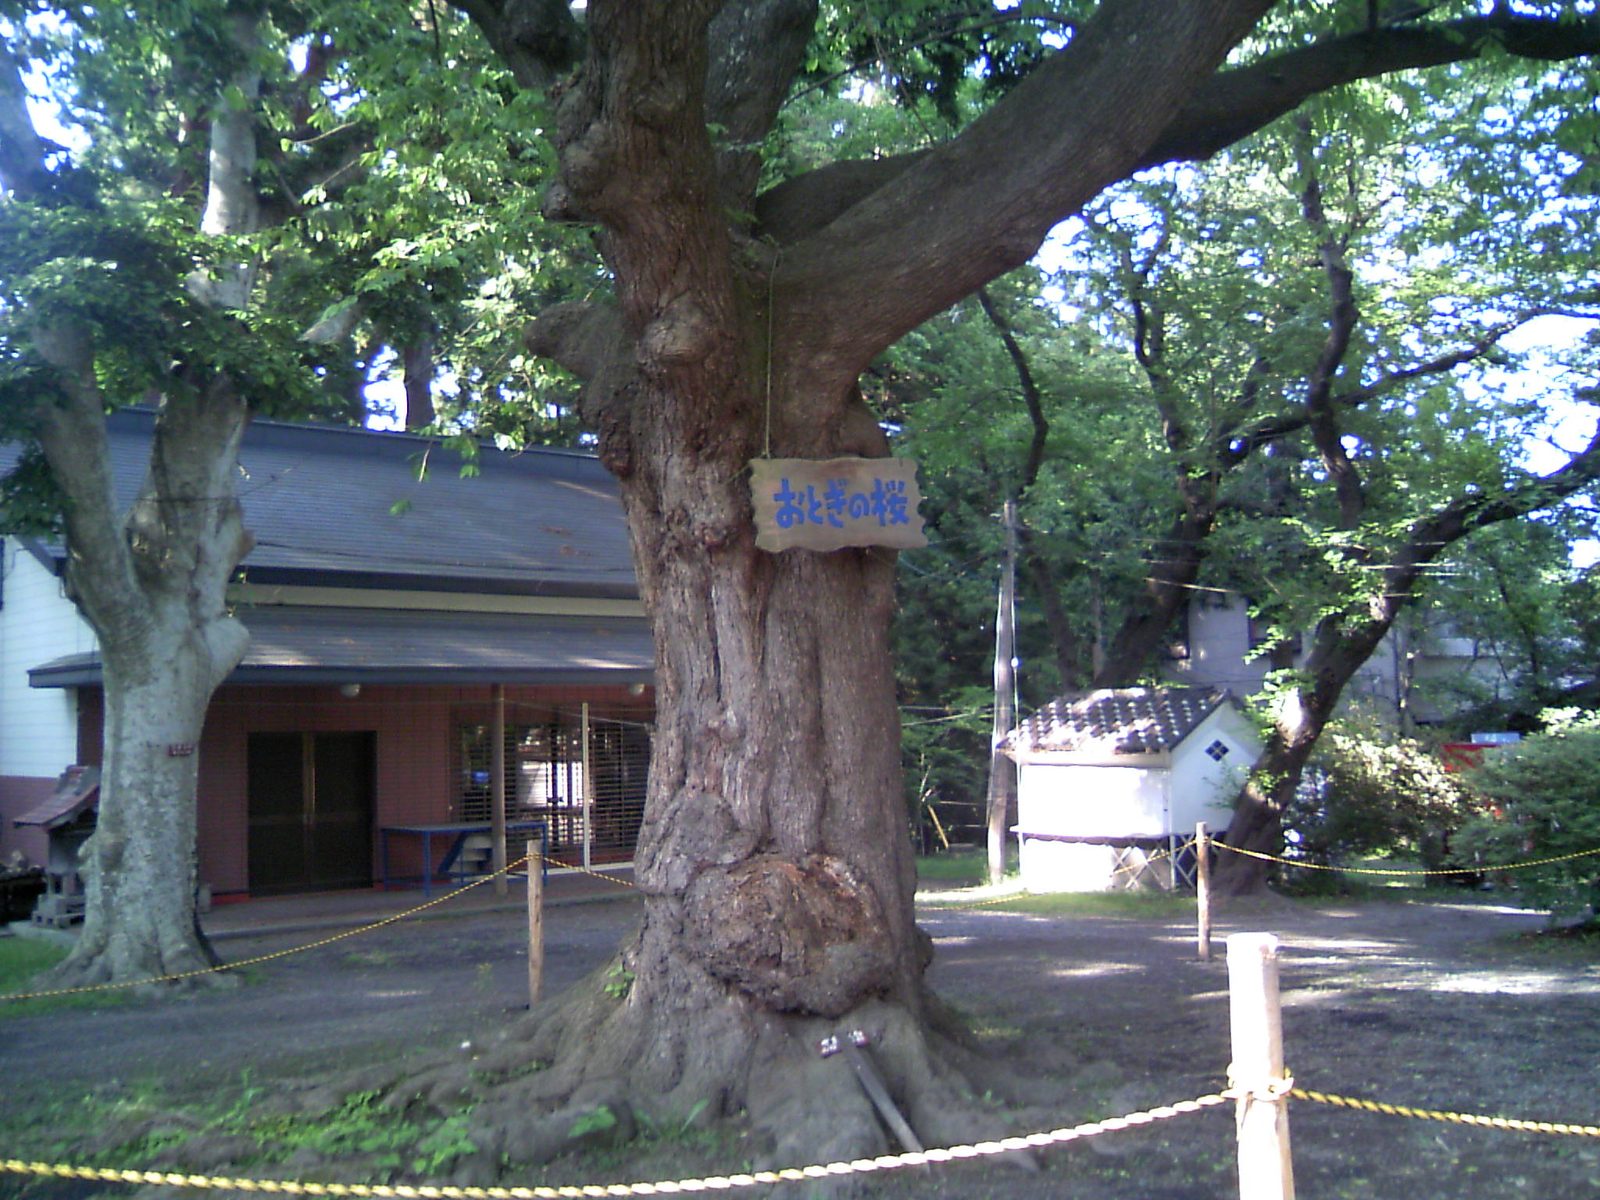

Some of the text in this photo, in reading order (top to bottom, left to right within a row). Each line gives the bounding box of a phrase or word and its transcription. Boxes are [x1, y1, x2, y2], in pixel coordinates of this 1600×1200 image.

[773, 478, 910, 529] おとぎの桜
